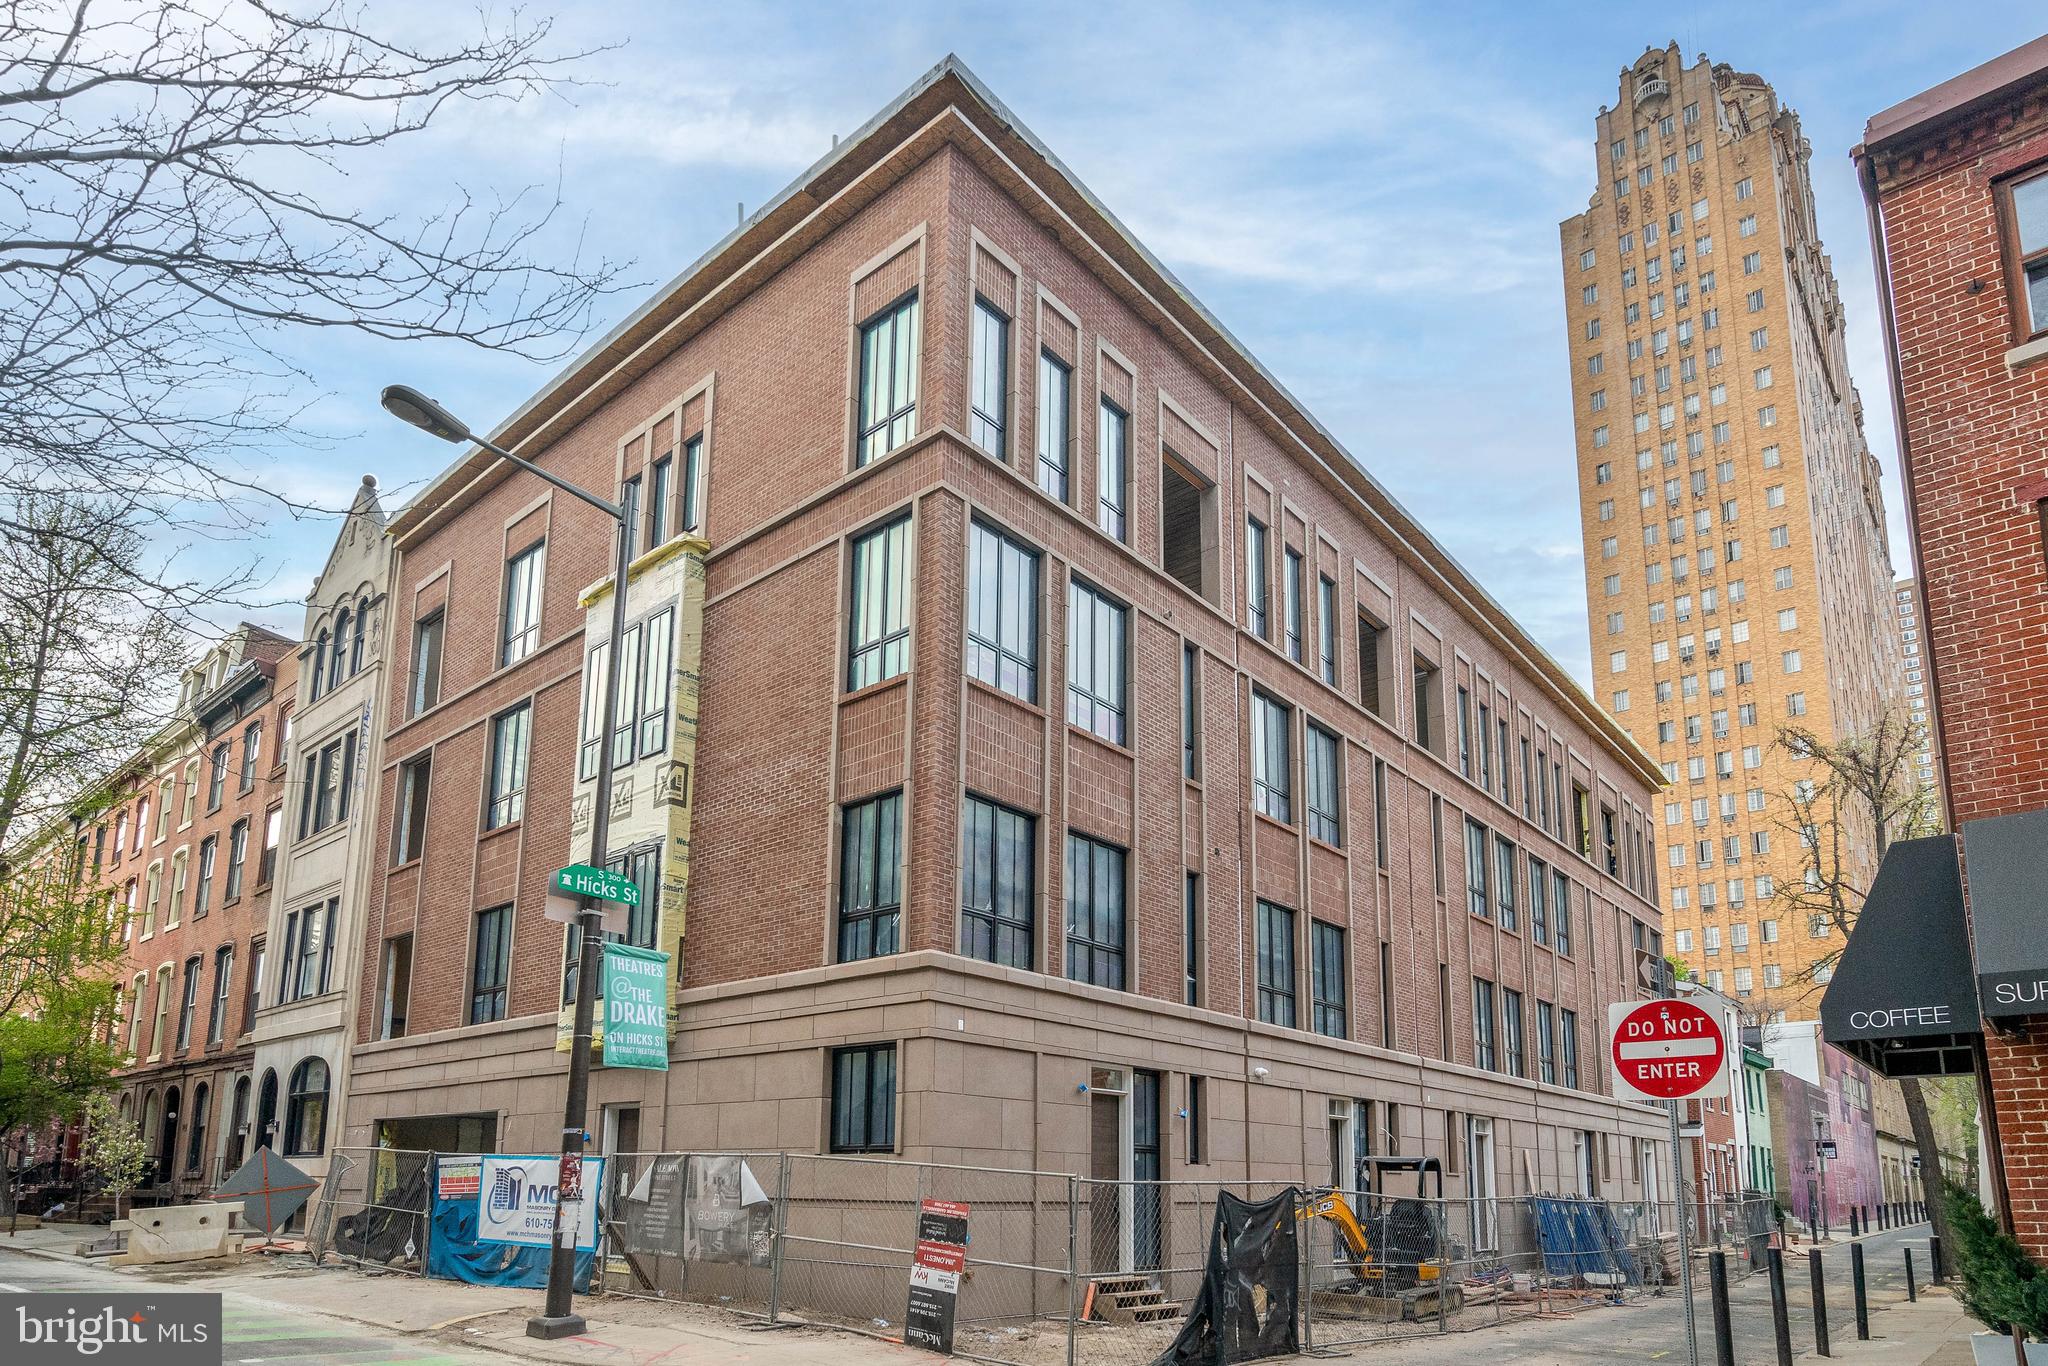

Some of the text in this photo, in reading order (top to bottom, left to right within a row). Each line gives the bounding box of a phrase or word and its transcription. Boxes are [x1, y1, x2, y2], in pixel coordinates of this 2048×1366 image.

[598, 870, 621, 882] S 300
[577, 874, 637, 903] Hicks St
[611, 956, 663, 978] THEATRES
[611, 1001, 665, 1028] DRAKE
[1850, 1005, 1951, 1029] COFFEE
[1628, 1017, 1705, 1037] DO NOT
[610, 1031, 624, 1044] ON
[626, 1032, 653, 1046] HICKS
[1638, 1062, 1700, 1080] ENTER
[698, 1210, 735, 1222] BOWERY
[1318, 1202, 1334, 1212] JCB
[908, 1329, 941, 1345] McCann
